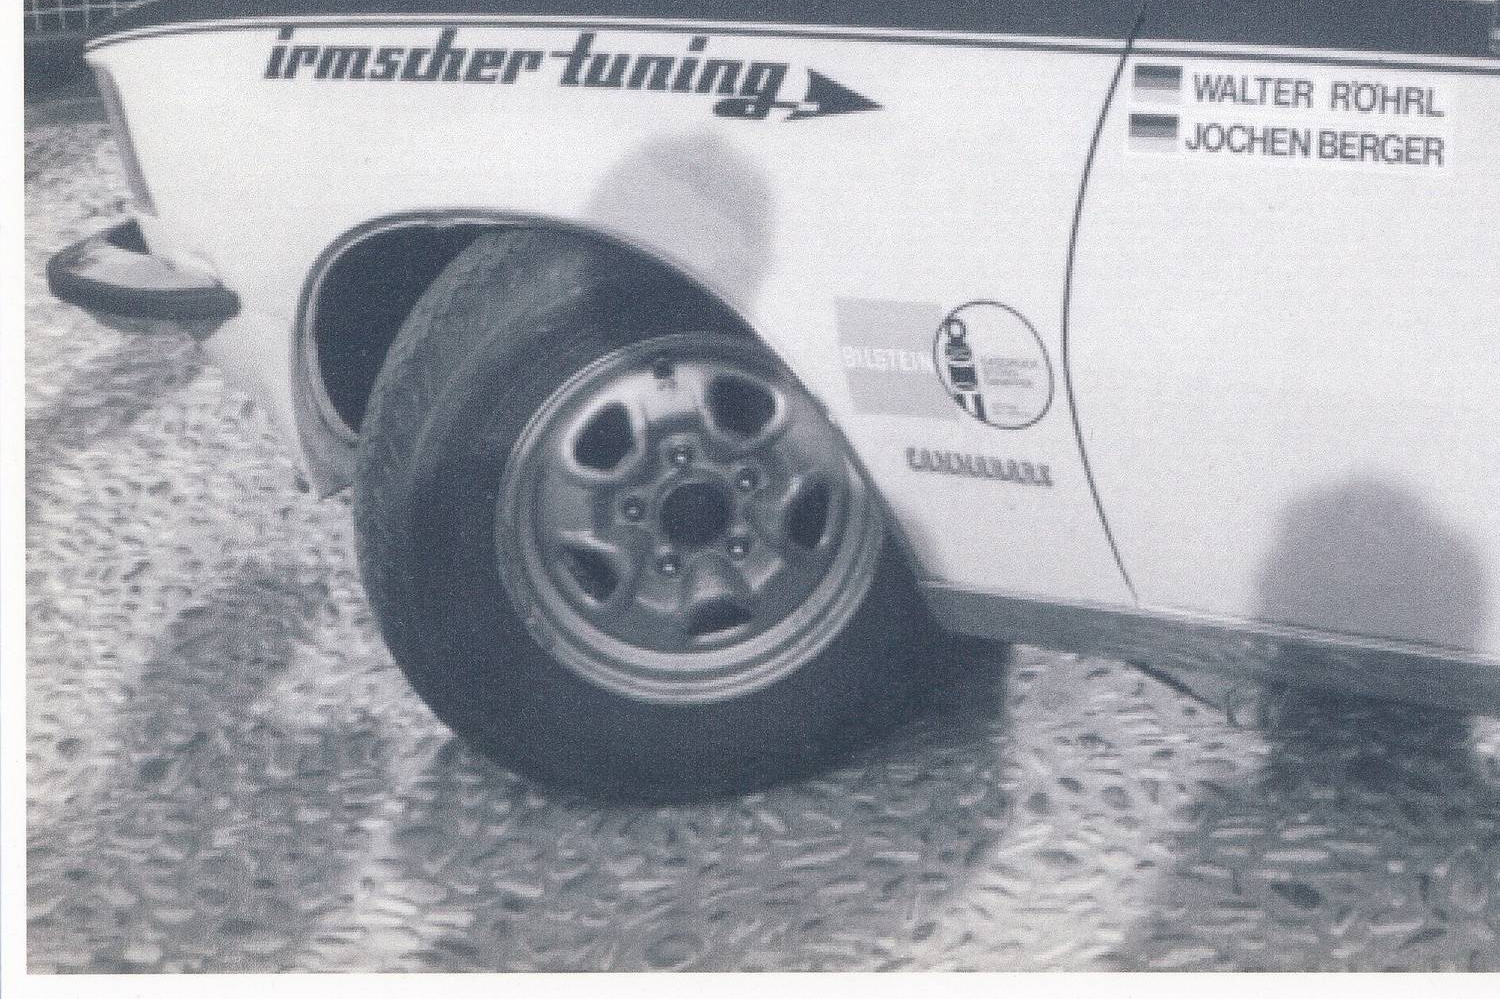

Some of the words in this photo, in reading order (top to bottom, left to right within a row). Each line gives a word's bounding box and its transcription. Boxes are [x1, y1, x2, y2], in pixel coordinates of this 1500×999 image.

[1193, 73, 1315, 109] WALTER
[1330, 80, 1445, 119] RÖHRL
[1185, 122, 1312, 158] JOCHEN
[1317, 129, 1446, 167] BERGER
